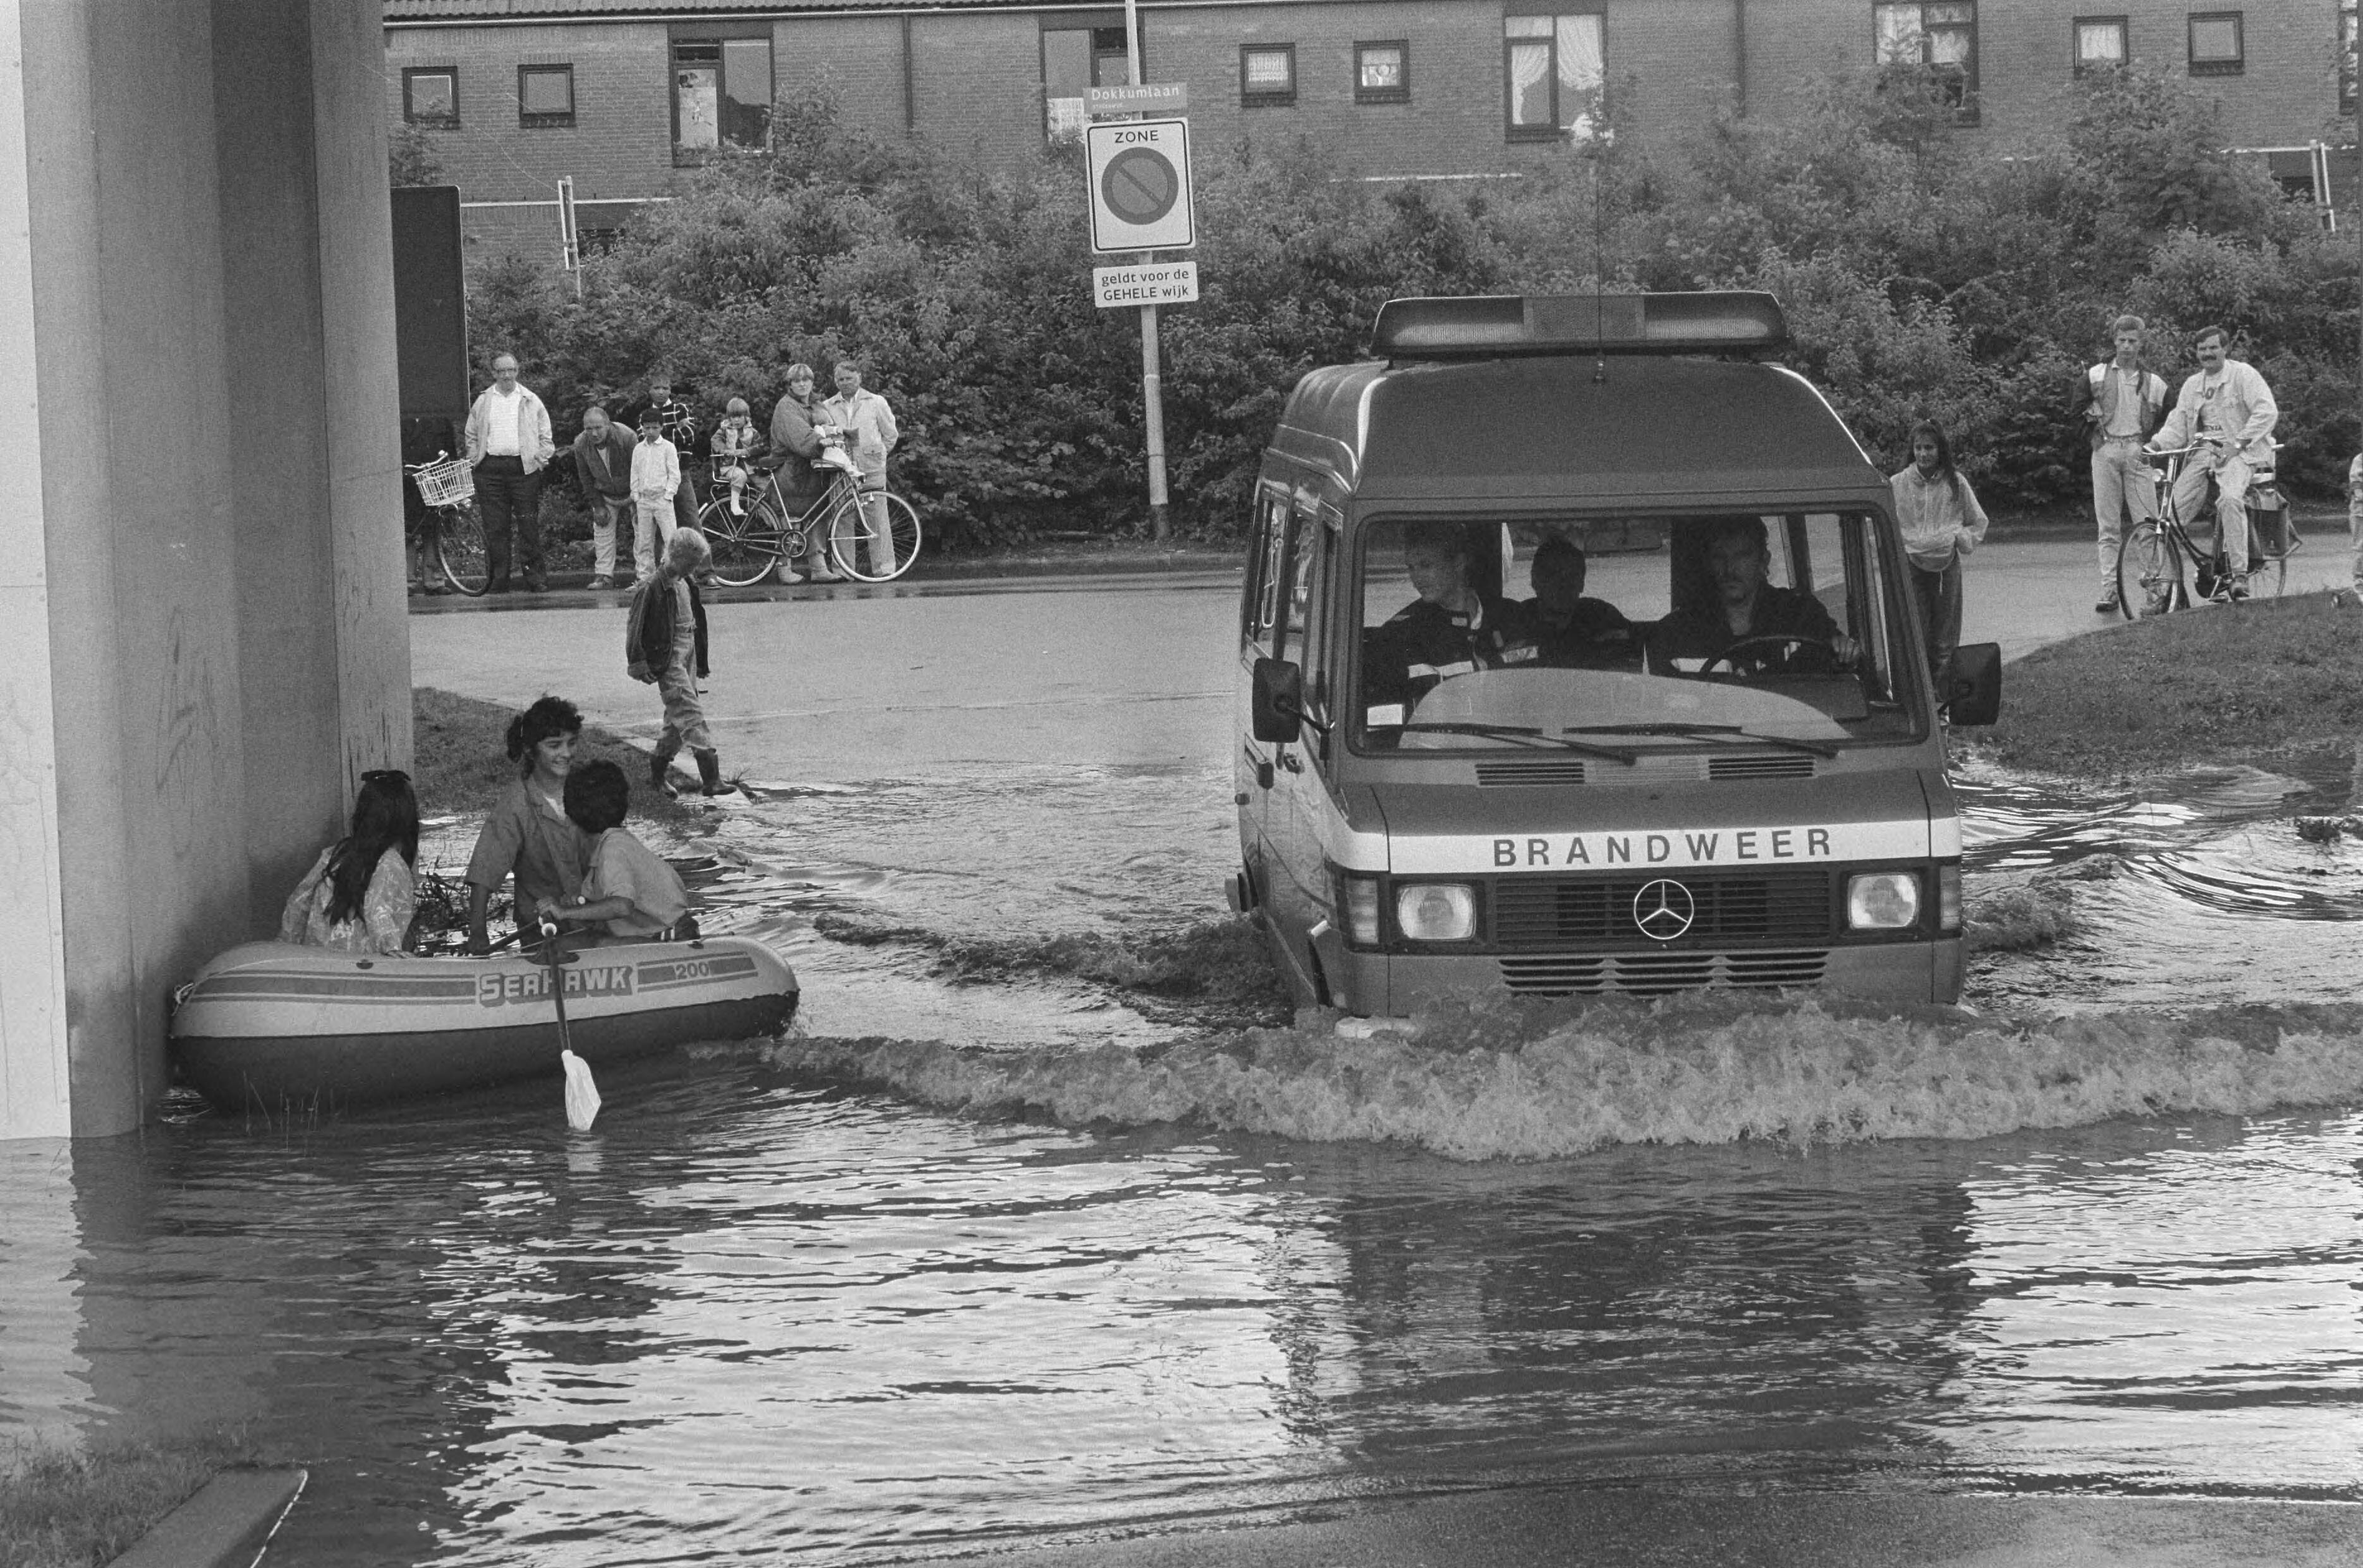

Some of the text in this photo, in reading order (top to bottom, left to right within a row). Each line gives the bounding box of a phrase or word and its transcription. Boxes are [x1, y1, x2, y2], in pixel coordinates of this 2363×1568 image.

[1091, 86, 1179, 100] Dokkumlaan
[1114, 130, 1159, 143] ZONE
[1102, 269, 1189, 287] geldt voor de
[1103, 285, 1189, 301] GEHELE wijk
[1493, 827, 1831, 867] BRANDWEER
[675, 962, 709, 980] 200
